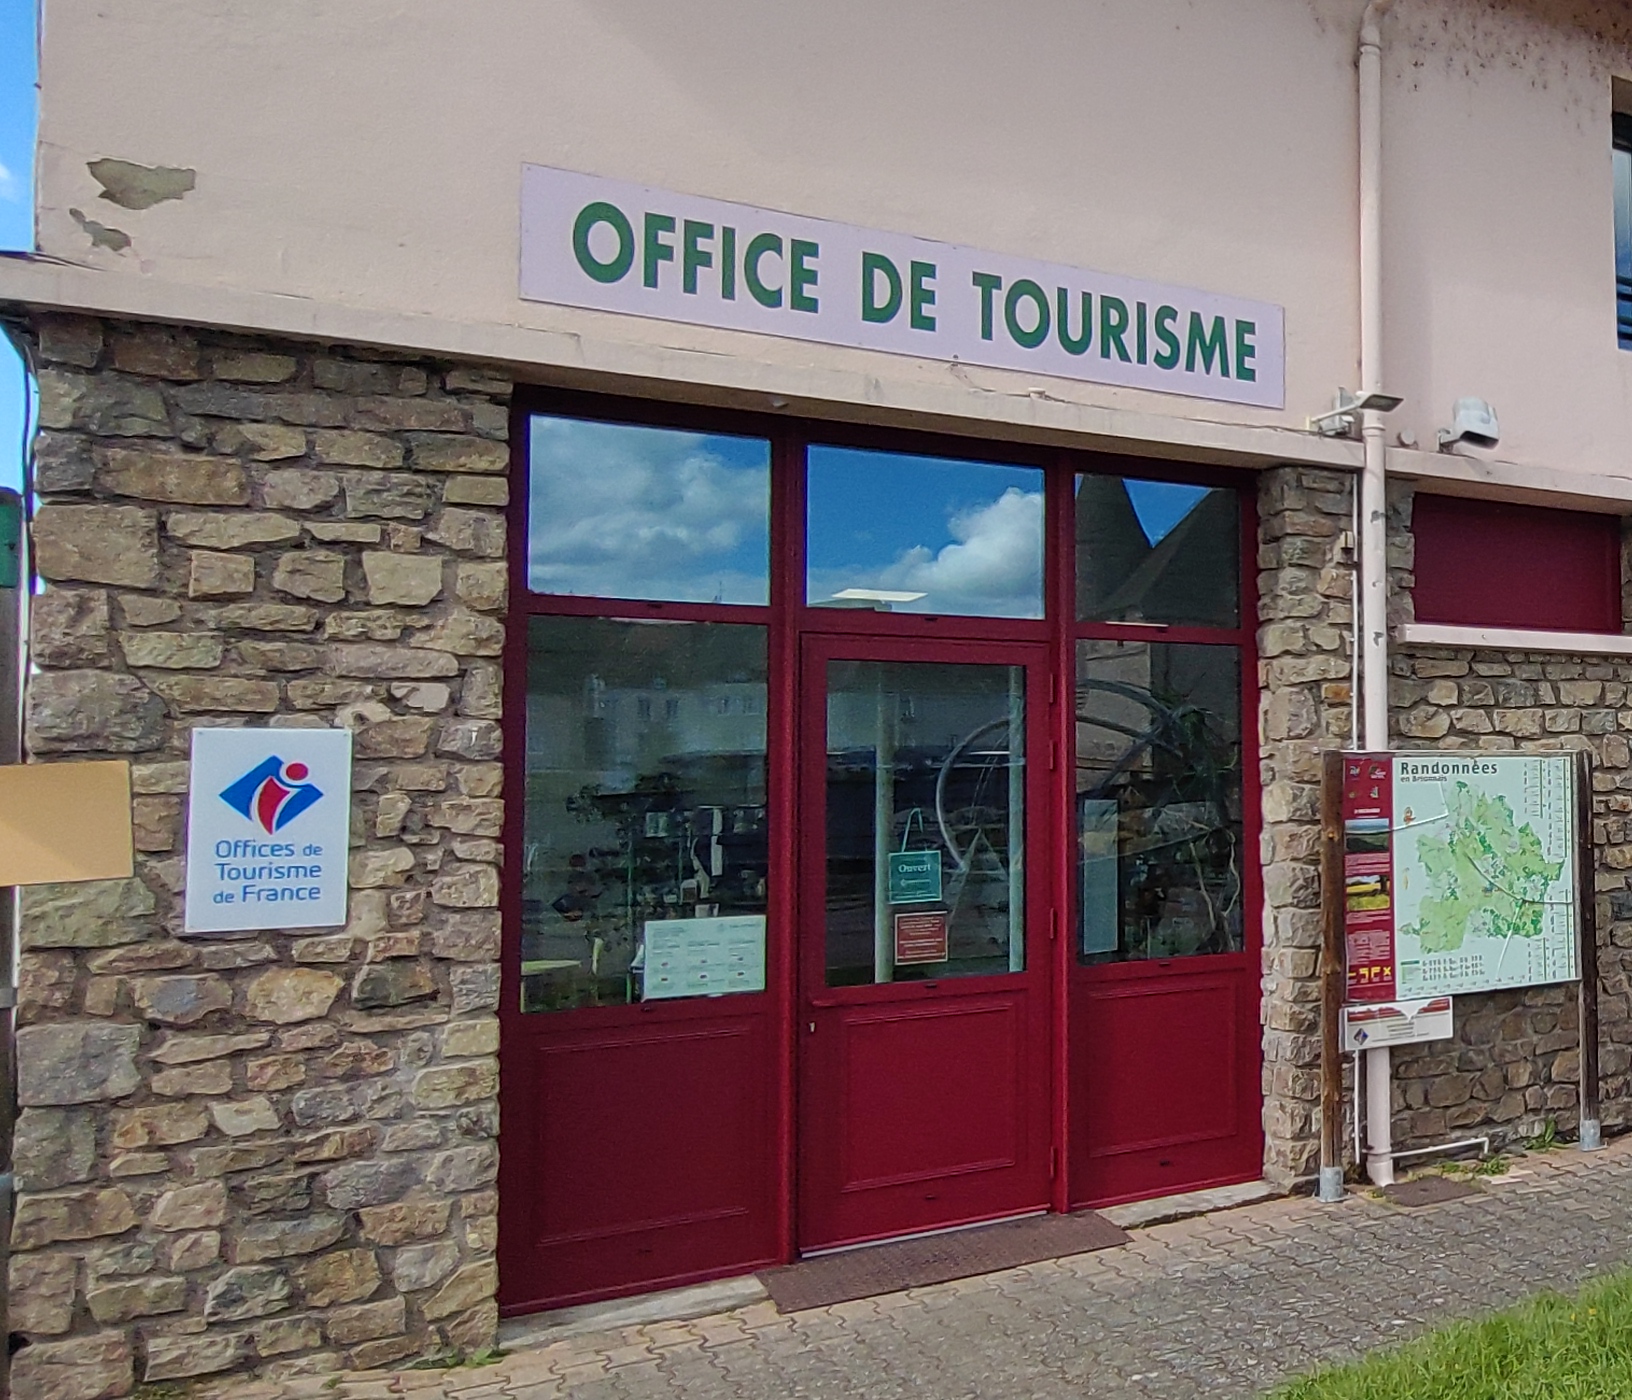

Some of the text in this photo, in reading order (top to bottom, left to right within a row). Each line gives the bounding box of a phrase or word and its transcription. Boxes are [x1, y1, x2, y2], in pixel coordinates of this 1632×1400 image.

[571, 201, 1258, 382] OFFICE DE TOURISME
[1400, 760, 1498, 775] Randonnées
[215, 839, 323, 858] Offices de
[214, 862, 322, 881] Tourisme
[898, 863, 931, 873] Ouvert
[212, 884, 321, 904] de France
